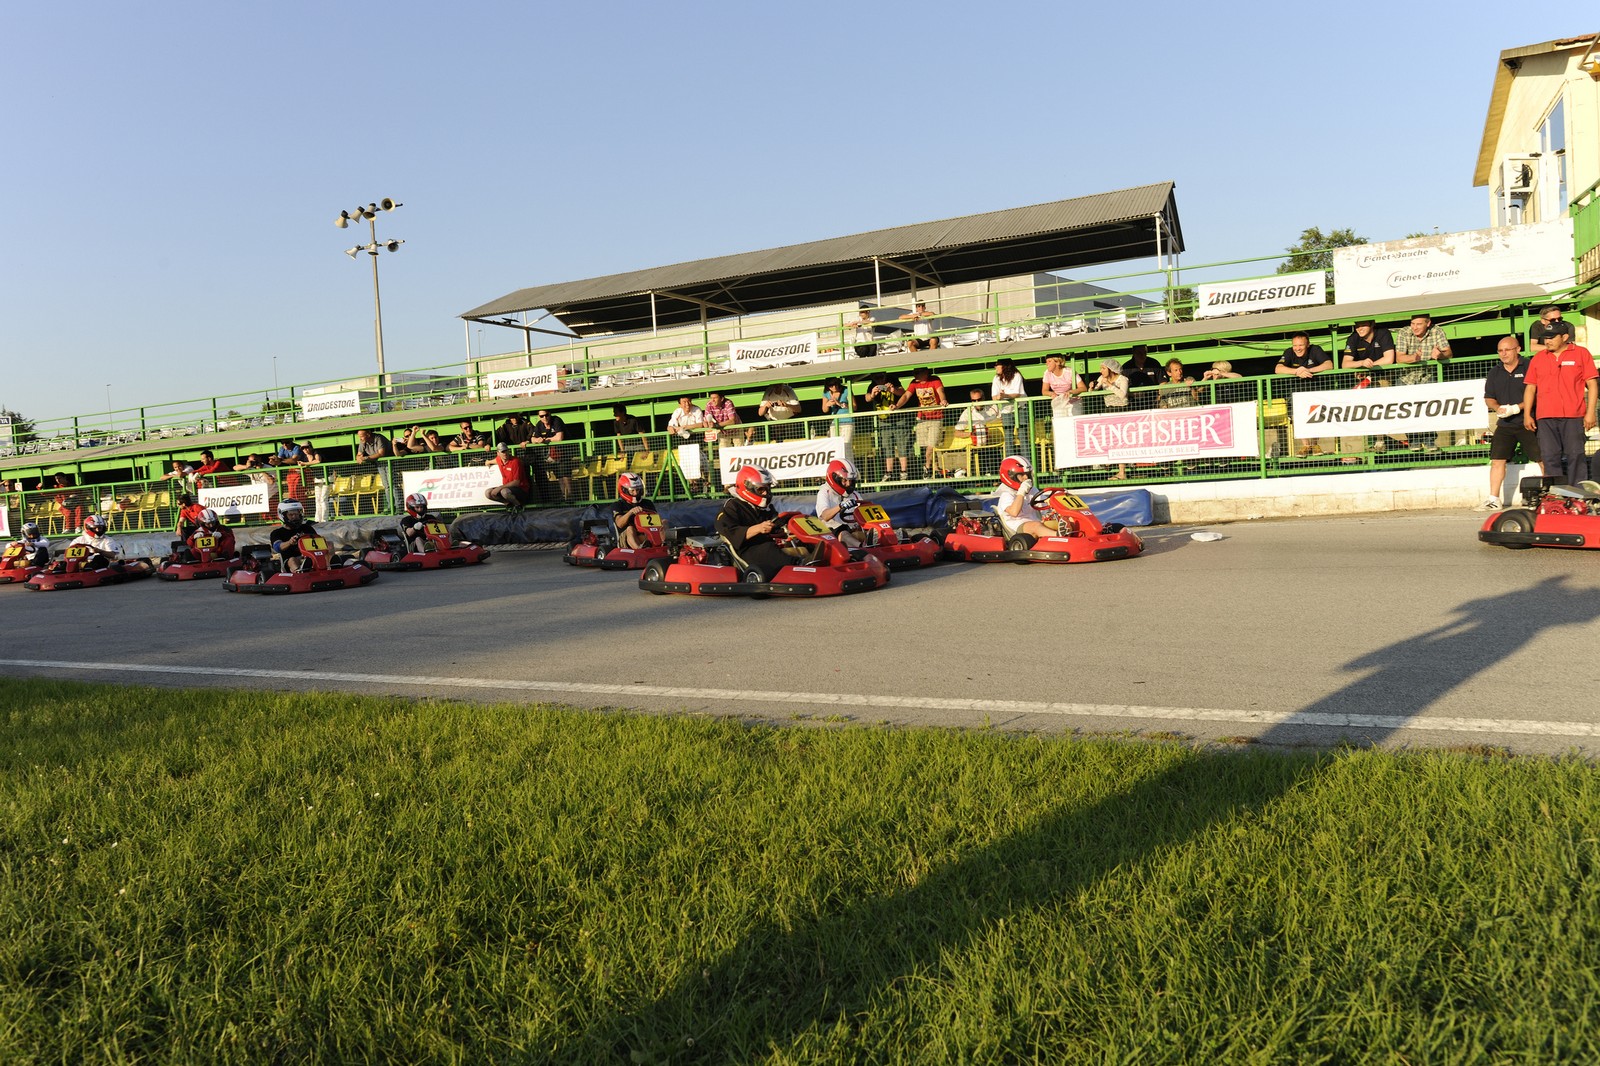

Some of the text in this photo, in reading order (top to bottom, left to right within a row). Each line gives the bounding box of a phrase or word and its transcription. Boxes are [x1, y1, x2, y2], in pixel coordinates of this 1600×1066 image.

[1208, 283, 1316, 306] BRIDGESTONE
[736, 342, 811, 360] BRIDGESTONE
[493, 374, 552, 389] BRIDGESTONE
[307, 399, 356, 412] BRIDGESTONE
[1306, 397, 1474, 424] BRIDGESTONE
[1081, 414, 1225, 453] KINGFISHER
[447, 471, 490, 482] SAHARA
[427, 488, 473, 500] India
[204, 494, 263, 508] BRIDGESTONE
[646, 514, 655, 526] 2
[865, 507, 884, 520] 15
[201, 538, 211, 547] 13
[311, 539, 319, 549] 4
